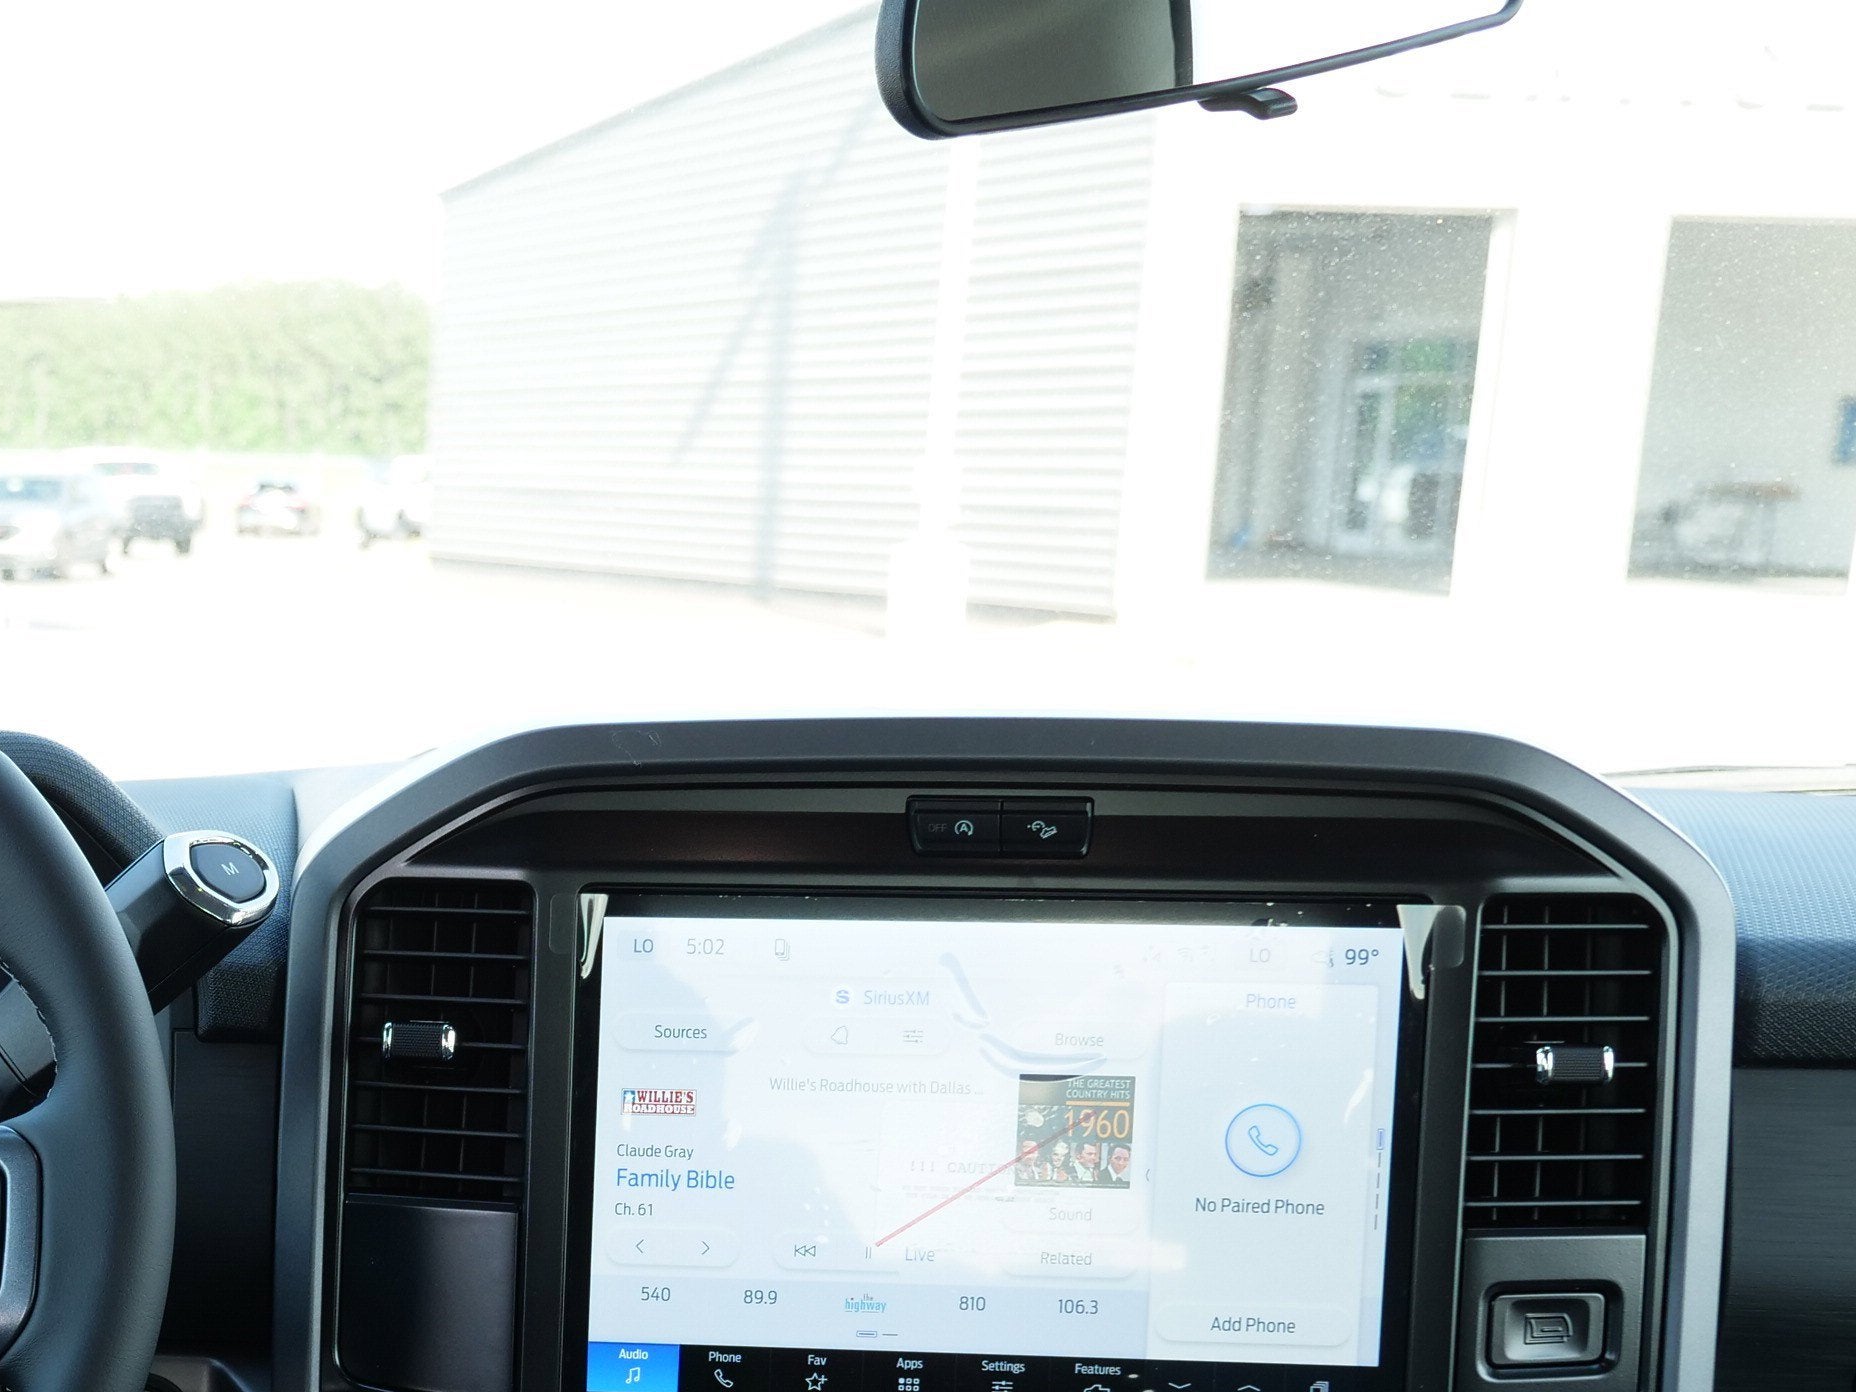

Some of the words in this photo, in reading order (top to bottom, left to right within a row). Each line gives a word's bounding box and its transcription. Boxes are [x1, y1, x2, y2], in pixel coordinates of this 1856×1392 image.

[221, 863, 239, 876] M
[633, 938, 654, 953] LO
[686, 938, 725, 955] 5:02
[1250, 948, 1271, 963] LO
[1345, 948, 1379, 965] 99°
[863, 990, 930, 1006] SiriusXM
[1246, 993, 1297, 1009] Phone
[654, 1025, 707, 1040] Sources
[1055, 1033, 1104, 1048] Browse
[769, 1078, 817, 1092] Willie's
[819, 1078, 894, 1094] Roadhouse
[896, 1080, 927, 1095] with
[930, 1081, 972, 1096] Dallas
[1087, 1080, 1131, 1089] GREATEST
[637, 1090, 694, 1104] WILLIE'S
[1066, 1089, 1108, 1099] COUNTRY
[1110, 1090, 1131, 1099] HITS
[1064, 1109, 1130, 1138] 1960
[616, 1144, 662, 1158] Claude
[664, 1145, 694, 1160] Gray
[616, 1168, 681, 1191] Family
[686, 1170, 735, 1190] Bible
[615, 1202, 635, 1217] Ch.
[637, 1203, 654, 1217] 61
[1049, 1206, 1092, 1222] Sound
[1195, 1198, 1215, 1213] No
[1220, 1198, 1270, 1214] Paired
[1275, 1200, 1325, 1216] Phone
[905, 1248, 935, 1263] Live
[1040, 1252, 1093, 1266] Related
[641, 1287, 671, 1301] 540
[744, 1289, 778, 1305] 89.9
[845, 1298, 887, 1313] highway
[959, 1296, 986, 1311] 810
[1058, 1299, 1099, 1315] 106.3
[1210, 1317, 1242, 1332] Add
[1245, 1318, 1296, 1334] Phone
[618, 1348, 649, 1360] Audio
[708, 1352, 742, 1363] Phone
[807, 1354, 827, 1366] Fav
[896, 1357, 924, 1371] Apps
[981, 1360, 1025, 1374] Settings
[1075, 1363, 1121, 1376] Features
